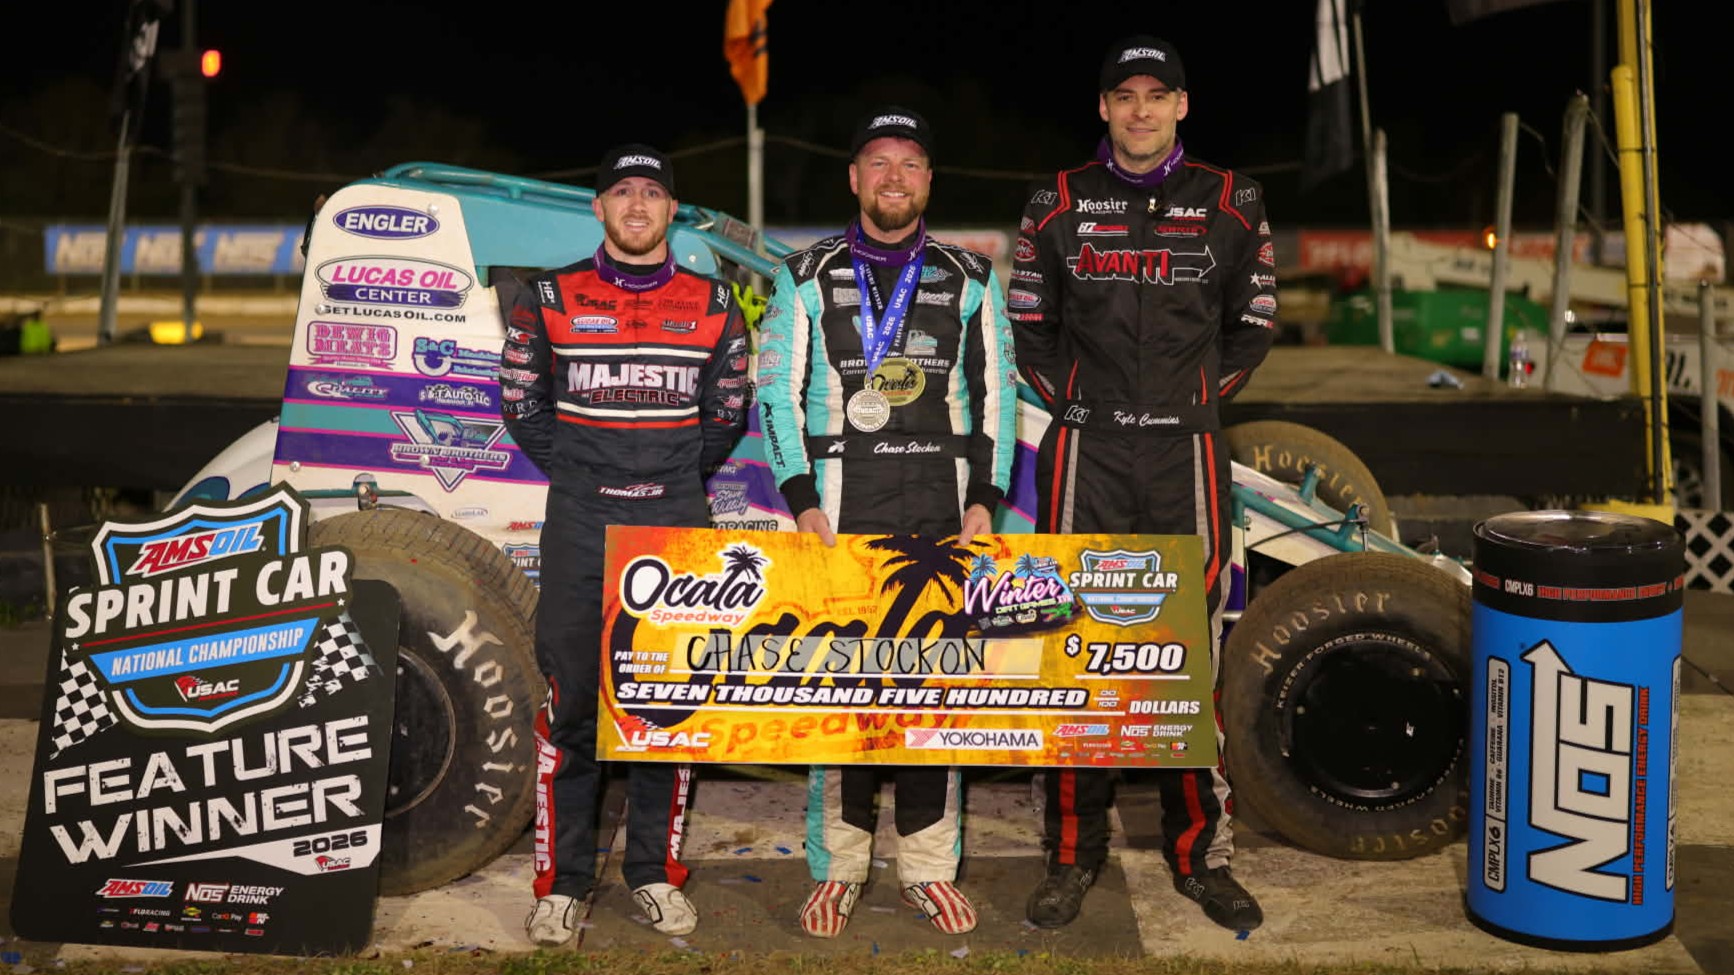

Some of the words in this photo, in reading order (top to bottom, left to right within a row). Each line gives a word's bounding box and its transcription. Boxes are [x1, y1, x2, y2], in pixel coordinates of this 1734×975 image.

[1118, 48, 1166, 63] AMSOIL
[868, 115, 917, 129] AMSOIL
[614, 155, 661, 170] AMSOIL
[1076, 198, 1128, 213] Hoosier
[344, 213, 430, 234] ENGLER
[1074, 243, 1170, 278] AVANTI
[332, 264, 413, 287] LUCAS
[419, 271, 458, 290] OIL
[893, 287, 908, 309] USAC
[904, 264, 916, 284] 2026
[355, 288, 432, 304] CENTER
[568, 361, 700, 397] MAJESTIC
[444, 389, 472, 401] AUTO
[590, 389, 679, 406] ELECTRIC
[1113, 410, 1136, 426] Kyle
[1138, 413, 1180, 427] Cummins
[765, 419, 786, 468] IMPACT
[873, 442, 906, 454] Chase
[905, 441, 941, 454] Stockon
[125, 521, 265, 578] AMSOIL
[1094, 559, 1146, 571] AMSOIL
[623, 555, 765, 612] Ocala
[964, 571, 1060, 615] Winter
[1069, 572, 1136, 589] SPRINT
[1142, 571, 1178, 588] CAR
[1504, 578, 1534, 596] CMPLX6
[65, 568, 239, 640] SPRINT
[255, 550, 348, 606] CAR
[650, 609, 745, 624] Speedway
[1251, 592, 1392, 678] Hoosier
[111, 645, 184, 677] NATIONAL
[187, 626, 304, 668] CHAMPIONSHIP
[614, 651, 633, 661] PAY
[634, 651, 647, 661] TO
[649, 652, 668, 662] THE
[686, 634, 805, 673] CHASE
[825, 636, 986, 674] STOCKON
[1067, 636, 1079, 656] $
[1089, 645, 1184, 673] 7,500
[618, 663, 651, 674] ORDER
[652, 664, 667, 674] OF
[1275, 660, 1305, 710] KEIZER
[1304, 632, 1365, 661] FORGED
[187, 678, 240, 698] USAC
[617, 682, 707, 701] SEVEN
[715, 684, 874, 704] THOUSAND
[878, 687, 943, 705] FIVE
[945, 688, 1088, 707] HUNDRED
[1497, 682, 1505, 718] VITAMIN
[427, 609, 527, 829] Hoosier
[1128, 700, 1201, 715] DOLLARS
[1638, 686, 1650, 726] DRINK
[631, 730, 712, 747] USAC
[938, 731, 1040, 747] YOKOHAMA
[1052, 723, 1110, 738] AMSOIL
[1120, 725, 1152, 737] NOS
[1153, 724, 1193, 732] ENERGY
[1496, 725, 1504, 763] GUARANA
[1636, 727, 1649, 776] ENERGY
[43, 715, 372, 815] FEATURE
[1527, 640, 1635, 904] NOS
[1495, 779, 1503, 813] VITAMIN
[49, 774, 366, 865] WINNER
[670, 767, 691, 860] MAJES
[1634, 778, 1647, 873] PERFORMANCE
[293, 829, 368, 857] 2026
[1486, 825, 1501, 884] CMPLX6
[96, 878, 174, 898] AMSOIL
[184, 881, 230, 903] NOS
[227, 894, 269, 905] DRINK
[231, 884, 285, 897] ENERGY
[1632, 876, 1643, 905] HIGH
